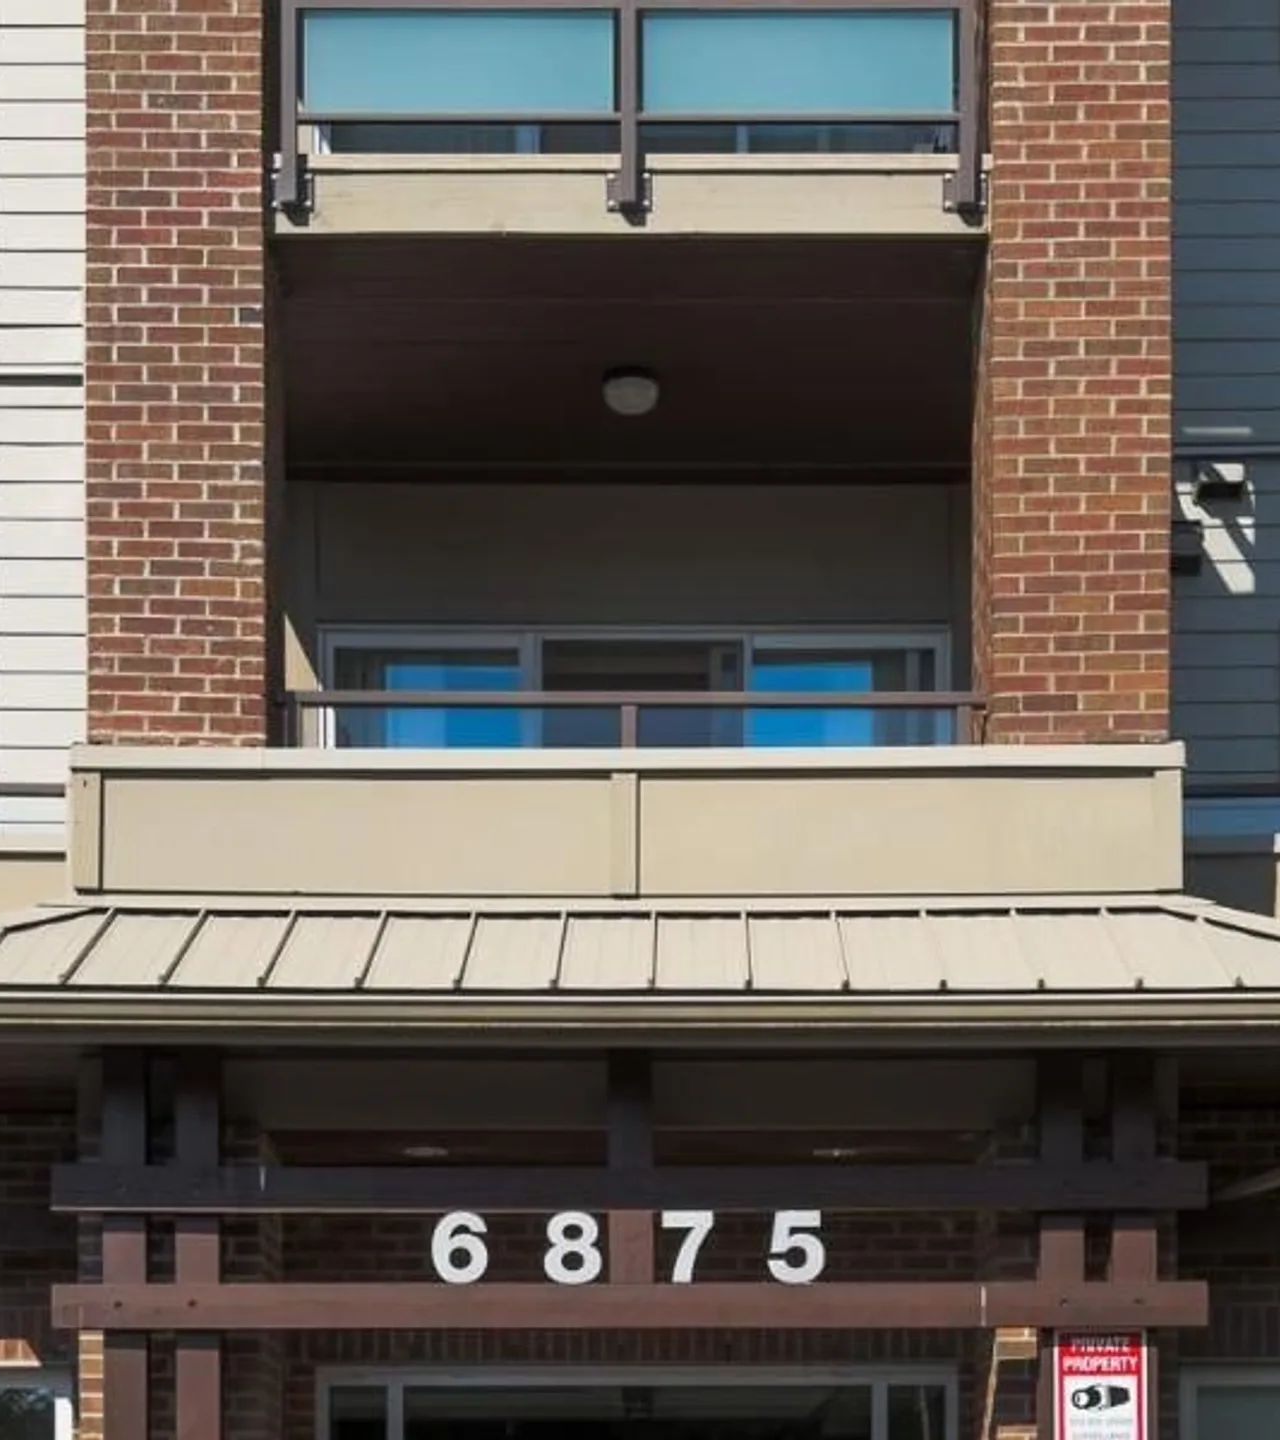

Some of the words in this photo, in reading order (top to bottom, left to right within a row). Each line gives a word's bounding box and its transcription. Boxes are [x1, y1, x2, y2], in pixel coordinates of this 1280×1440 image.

[431, 1210, 827, 1285] 6875
[1071, 1336, 1131, 1353] PRIVATE
[1062, 1356, 1138, 1371] PROPERTY
